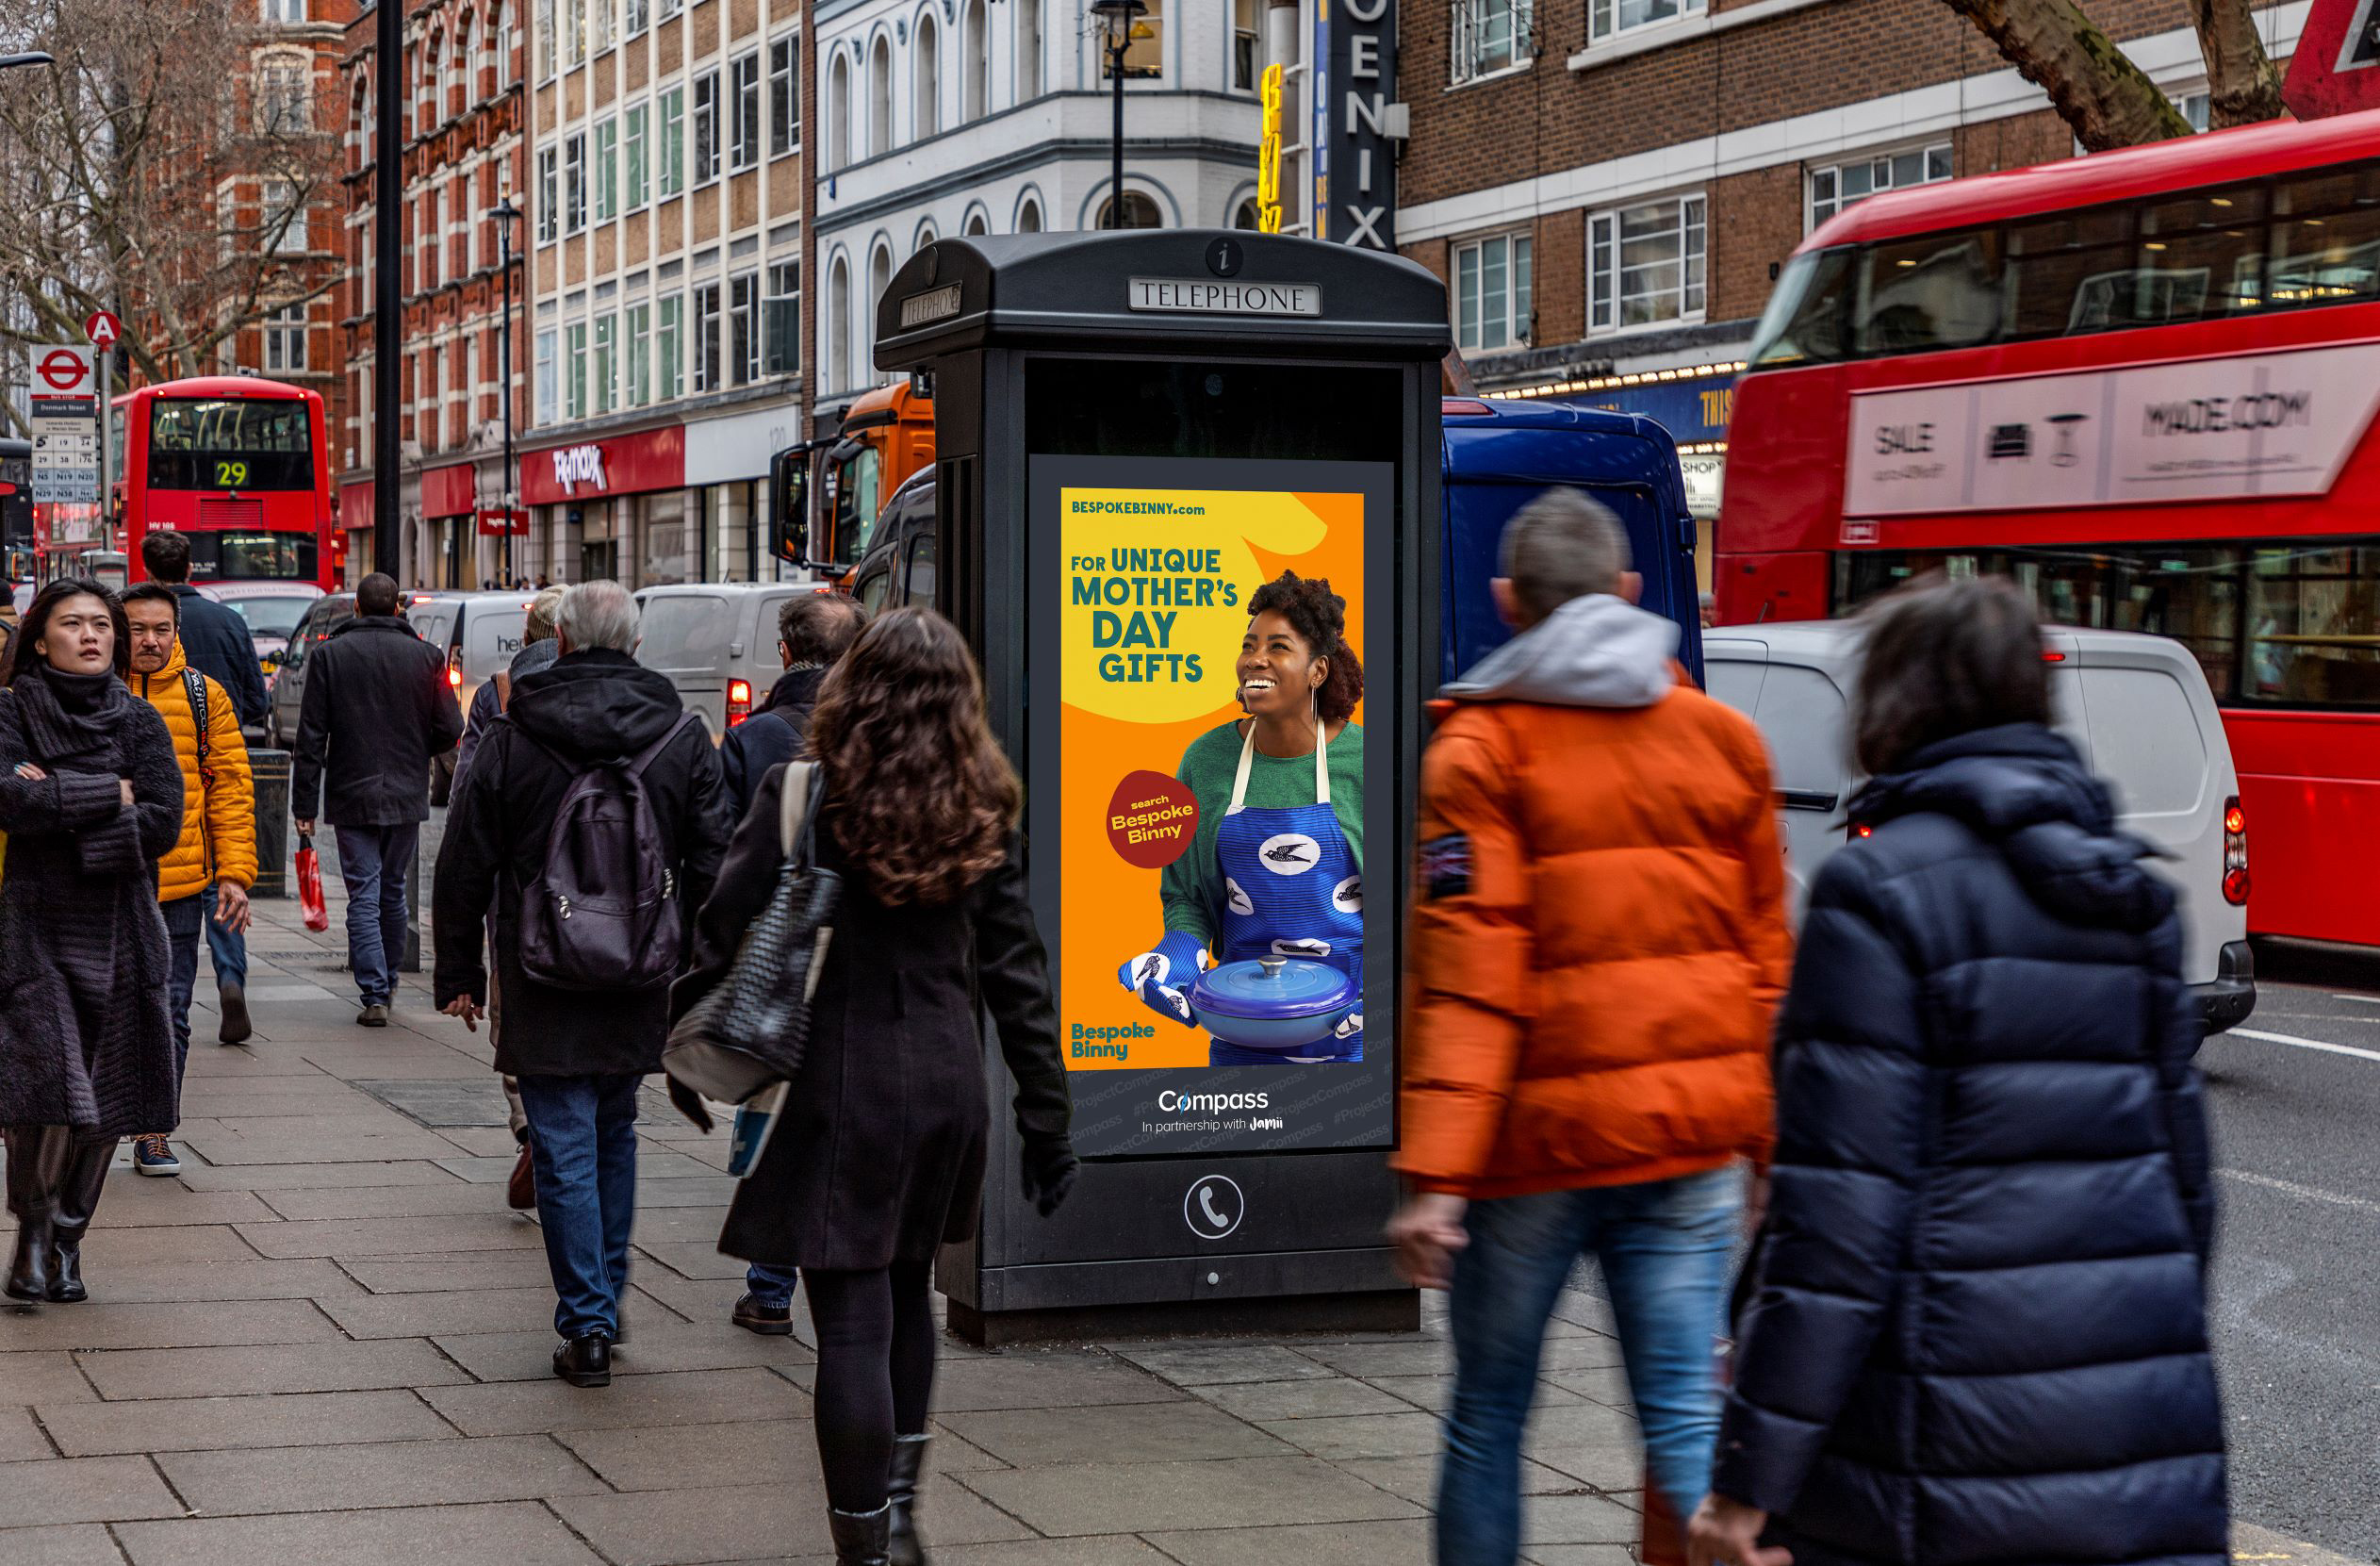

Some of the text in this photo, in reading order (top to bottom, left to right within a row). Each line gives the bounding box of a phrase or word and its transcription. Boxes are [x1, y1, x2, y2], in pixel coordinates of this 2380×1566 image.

[1139, 283, 1305, 312] TELEPHONE
[92, 315, 115, 339] A
[217, 462, 247, 485] 29
[1072, 502, 1206, 515] BESPOKEBINNY.com
[1071, 548, 1221, 573] FOR UNIQUE
[1072, 576, 1239, 607] MOTHER'S
[1092, 610, 1178, 649] DAY
[1098, 653, 1203, 683] GIFTS
[1130, 795, 1170, 810] search
[1110, 803, 1193, 831] Bespoke
[1127, 824, 1182, 845] Binny
[1071, 1021, 1156, 1043] Bespoke
[1071, 1041, 1128, 1062] Binny
[1157, 1090, 1270, 1115] Compass
[1142, 1116, 1283, 1134] In partnership with Jamii
